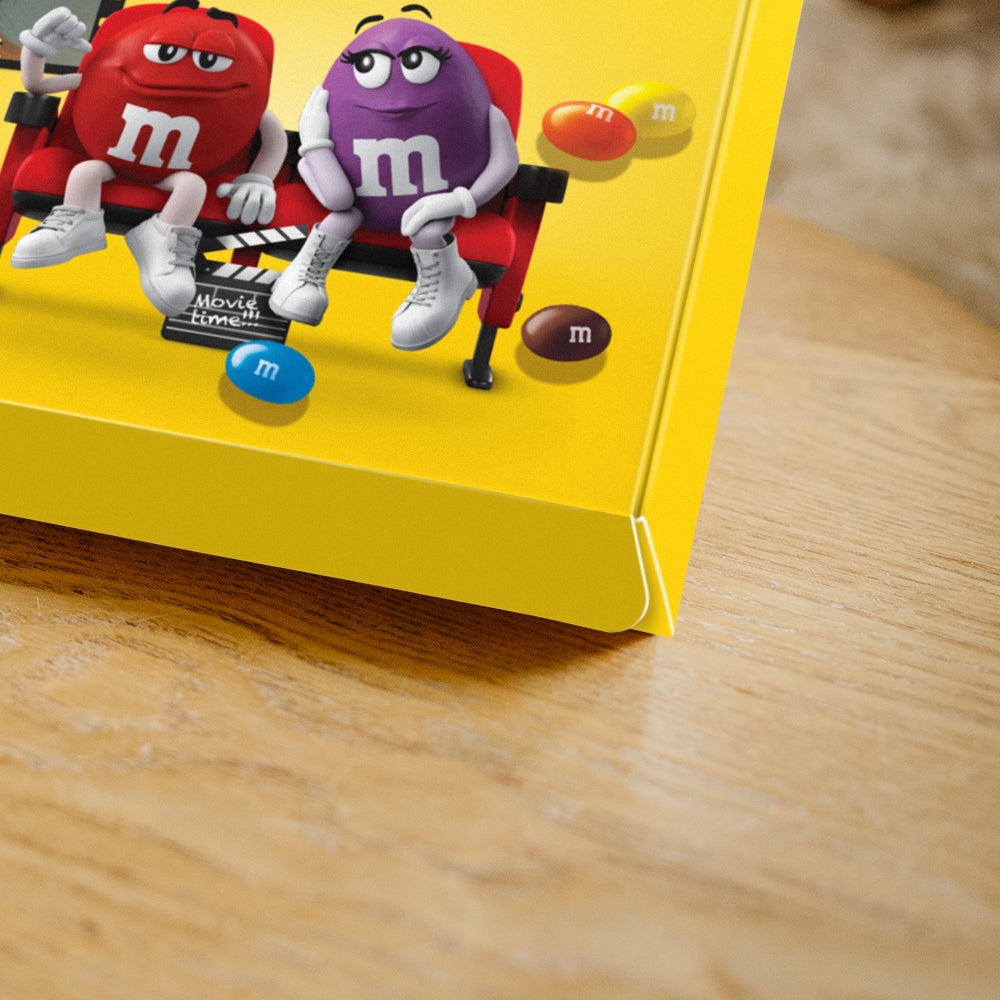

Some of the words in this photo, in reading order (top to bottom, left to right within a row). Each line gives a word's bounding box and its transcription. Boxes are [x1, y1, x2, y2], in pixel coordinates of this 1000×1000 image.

[585, 102, 615, 123] m
[651, 102, 677, 122] m
[105, 102, 201, 171] m
[352, 134, 449, 198] m
[192, 293, 260, 311] Movie
[569, 325, 593, 344] m
[253, 358, 280, 381] m
